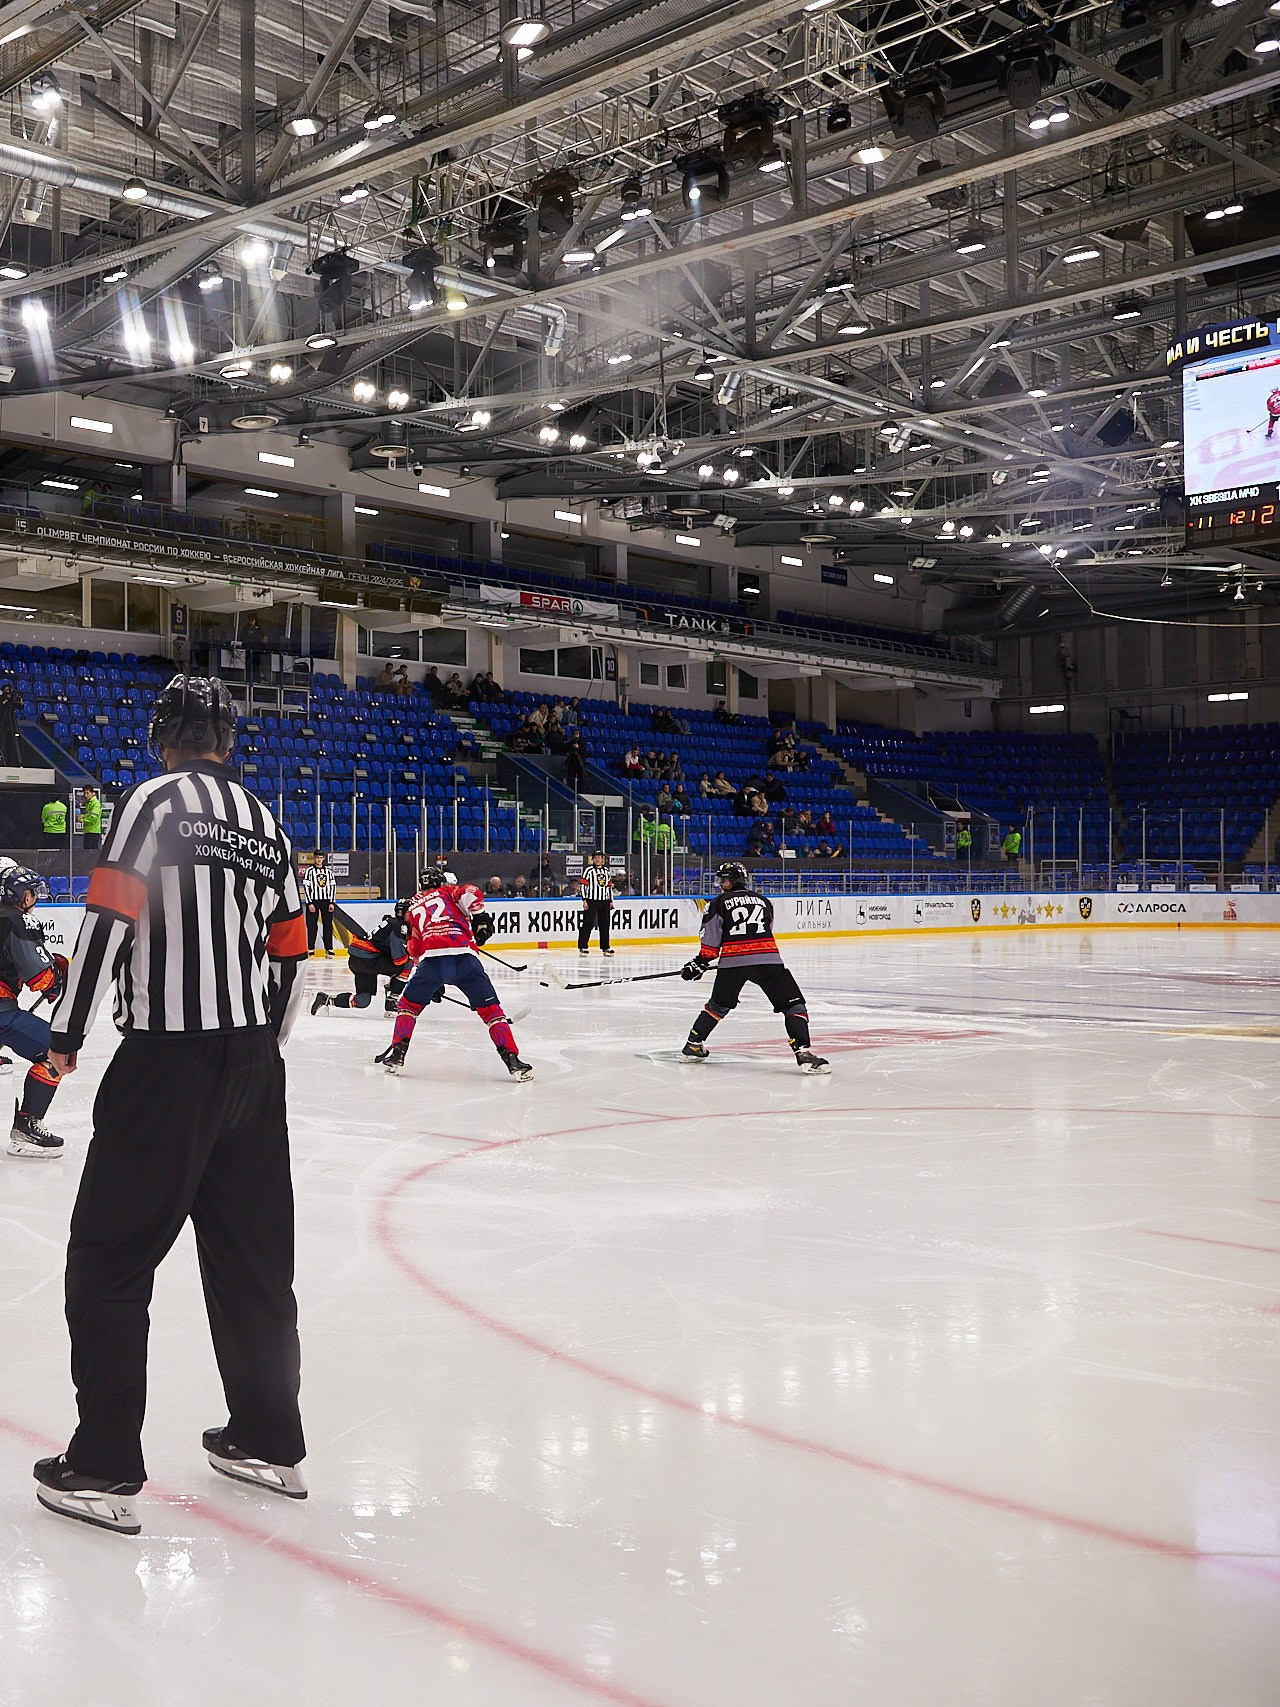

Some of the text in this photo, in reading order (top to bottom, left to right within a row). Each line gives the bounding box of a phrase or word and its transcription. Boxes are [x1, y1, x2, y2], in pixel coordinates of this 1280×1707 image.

[1186, 337, 1199, 355] И
[1205, 322, 1269, 348] ЧЕСТЬ
[201, 420, 206, 429] 7
[390, 460, 395, 468] 6
[1203, 489, 1238, 504] ЗВЕЗДА
[36, 526, 80, 541] OLIMPBET
[82, 533, 132, 549] ЧЕМПИОНАТ
[134, 541, 165, 553] РОССИИ
[167, 546, 178, 555] ПО
[180, 548, 211, 560] ХОККЕЮ
[223, 553, 283, 570] ВСЕРОССИЙСКАЯ
[284, 562, 325, 576] ХОККЕЙНАЯ
[327, 569, 345, 579] ЛИГА
[531, 595, 570, 611] SPAR
[175, 609, 183, 623] 9
[664, 613, 717, 633] TANK
[607, 659, 615, 672] 10
[795, 899, 833, 916] ЛИГА
[868, 903, 888, 911] НИЖНИЙ
[1135, 903, 1187, 913] АЛРОСА
[411, 897, 451, 933] 72
[638, 908, 679, 930] ЛИГА
[728, 905, 766, 936] 24
[868, 913, 891, 921] НОВГОРОД
[797, 920, 832, 930] СИЛЬНЫХ
